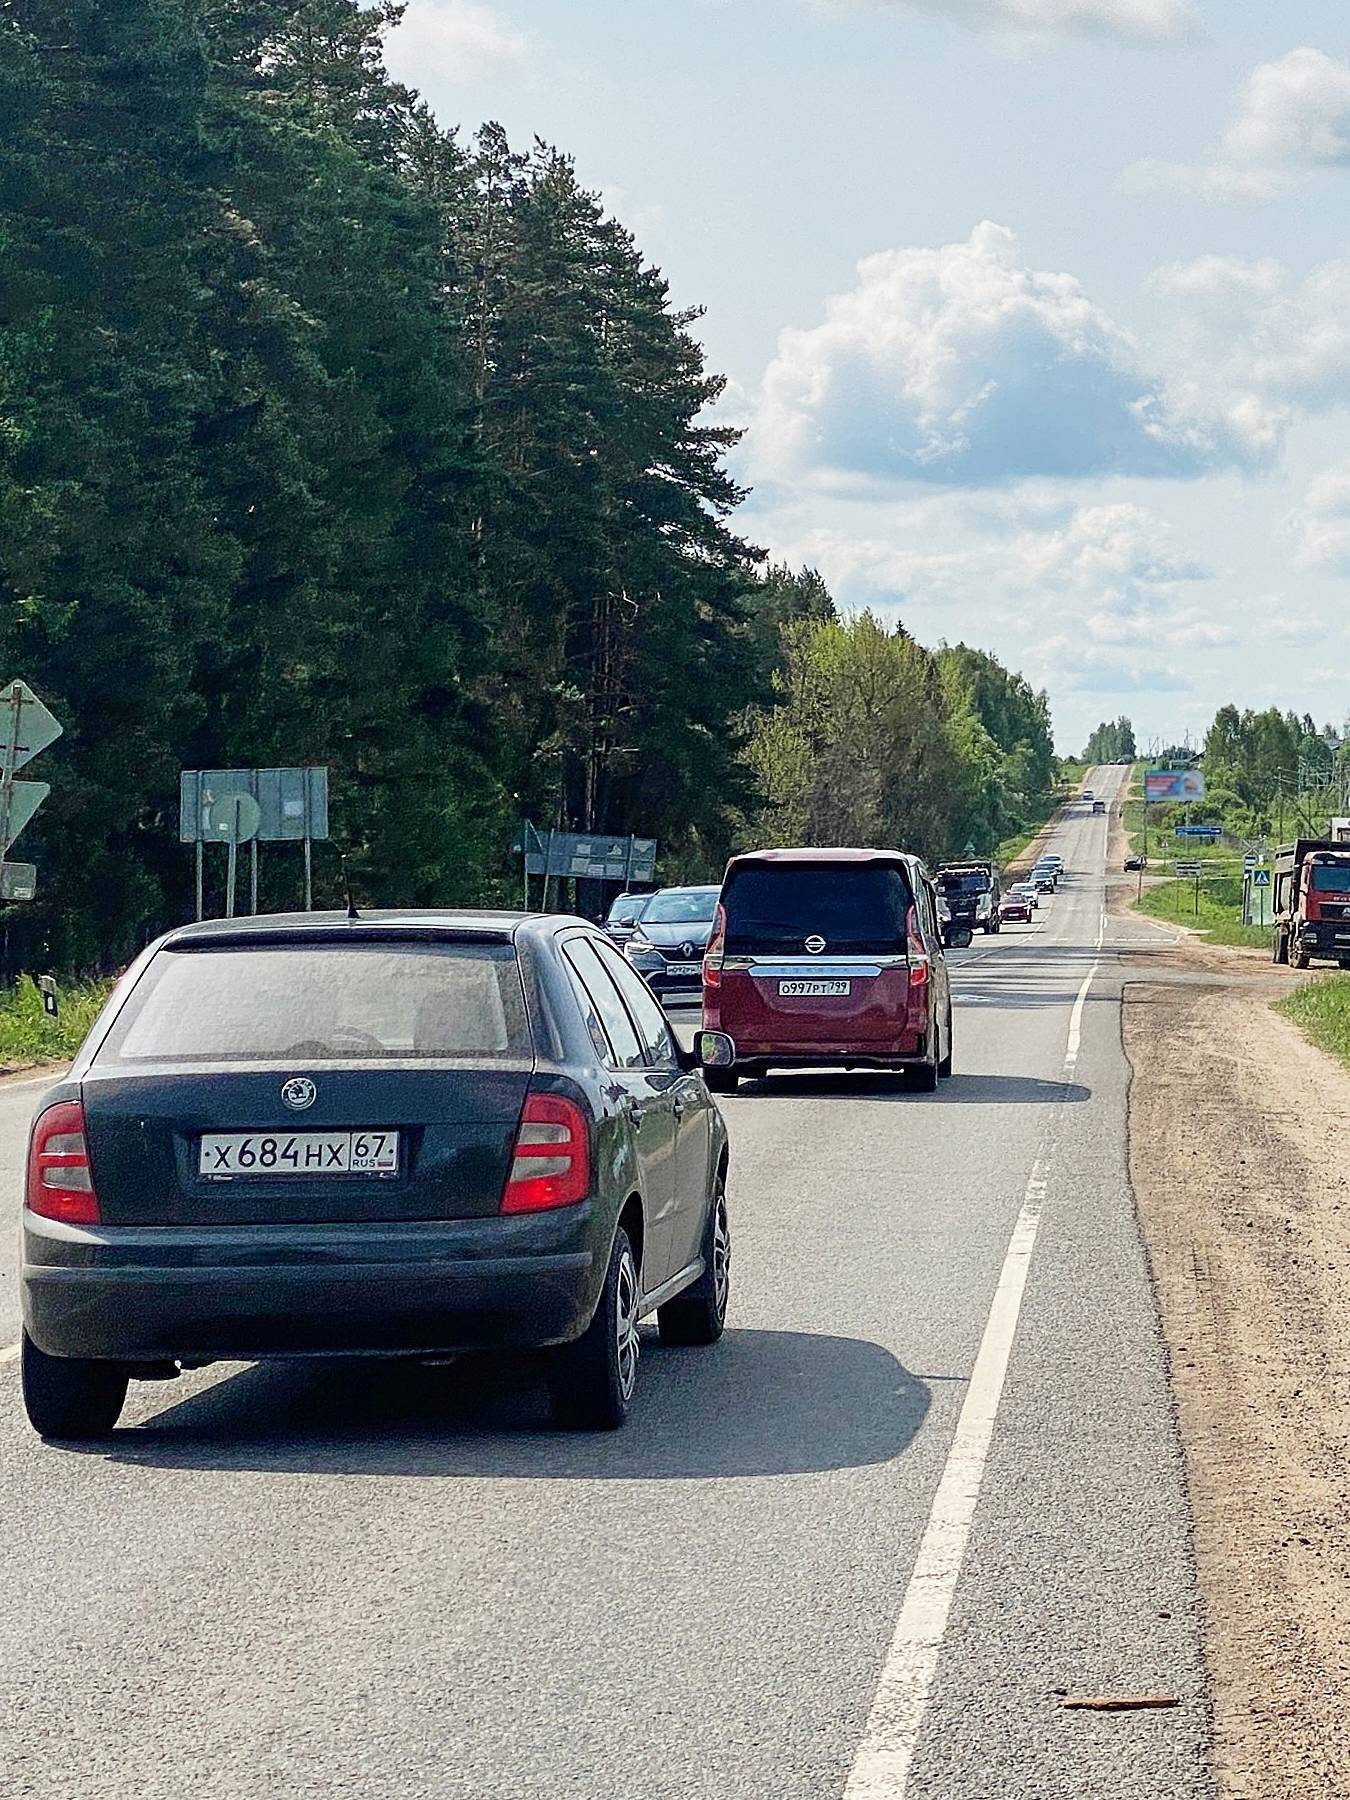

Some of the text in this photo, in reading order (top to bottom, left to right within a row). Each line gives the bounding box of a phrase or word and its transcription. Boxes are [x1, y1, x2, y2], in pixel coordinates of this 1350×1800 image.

[782, 983, 827, 993] О997РТ
[214, 1135, 386, 1168] Х684НХ 67
[353, 1159, 375, 1167] RUS
